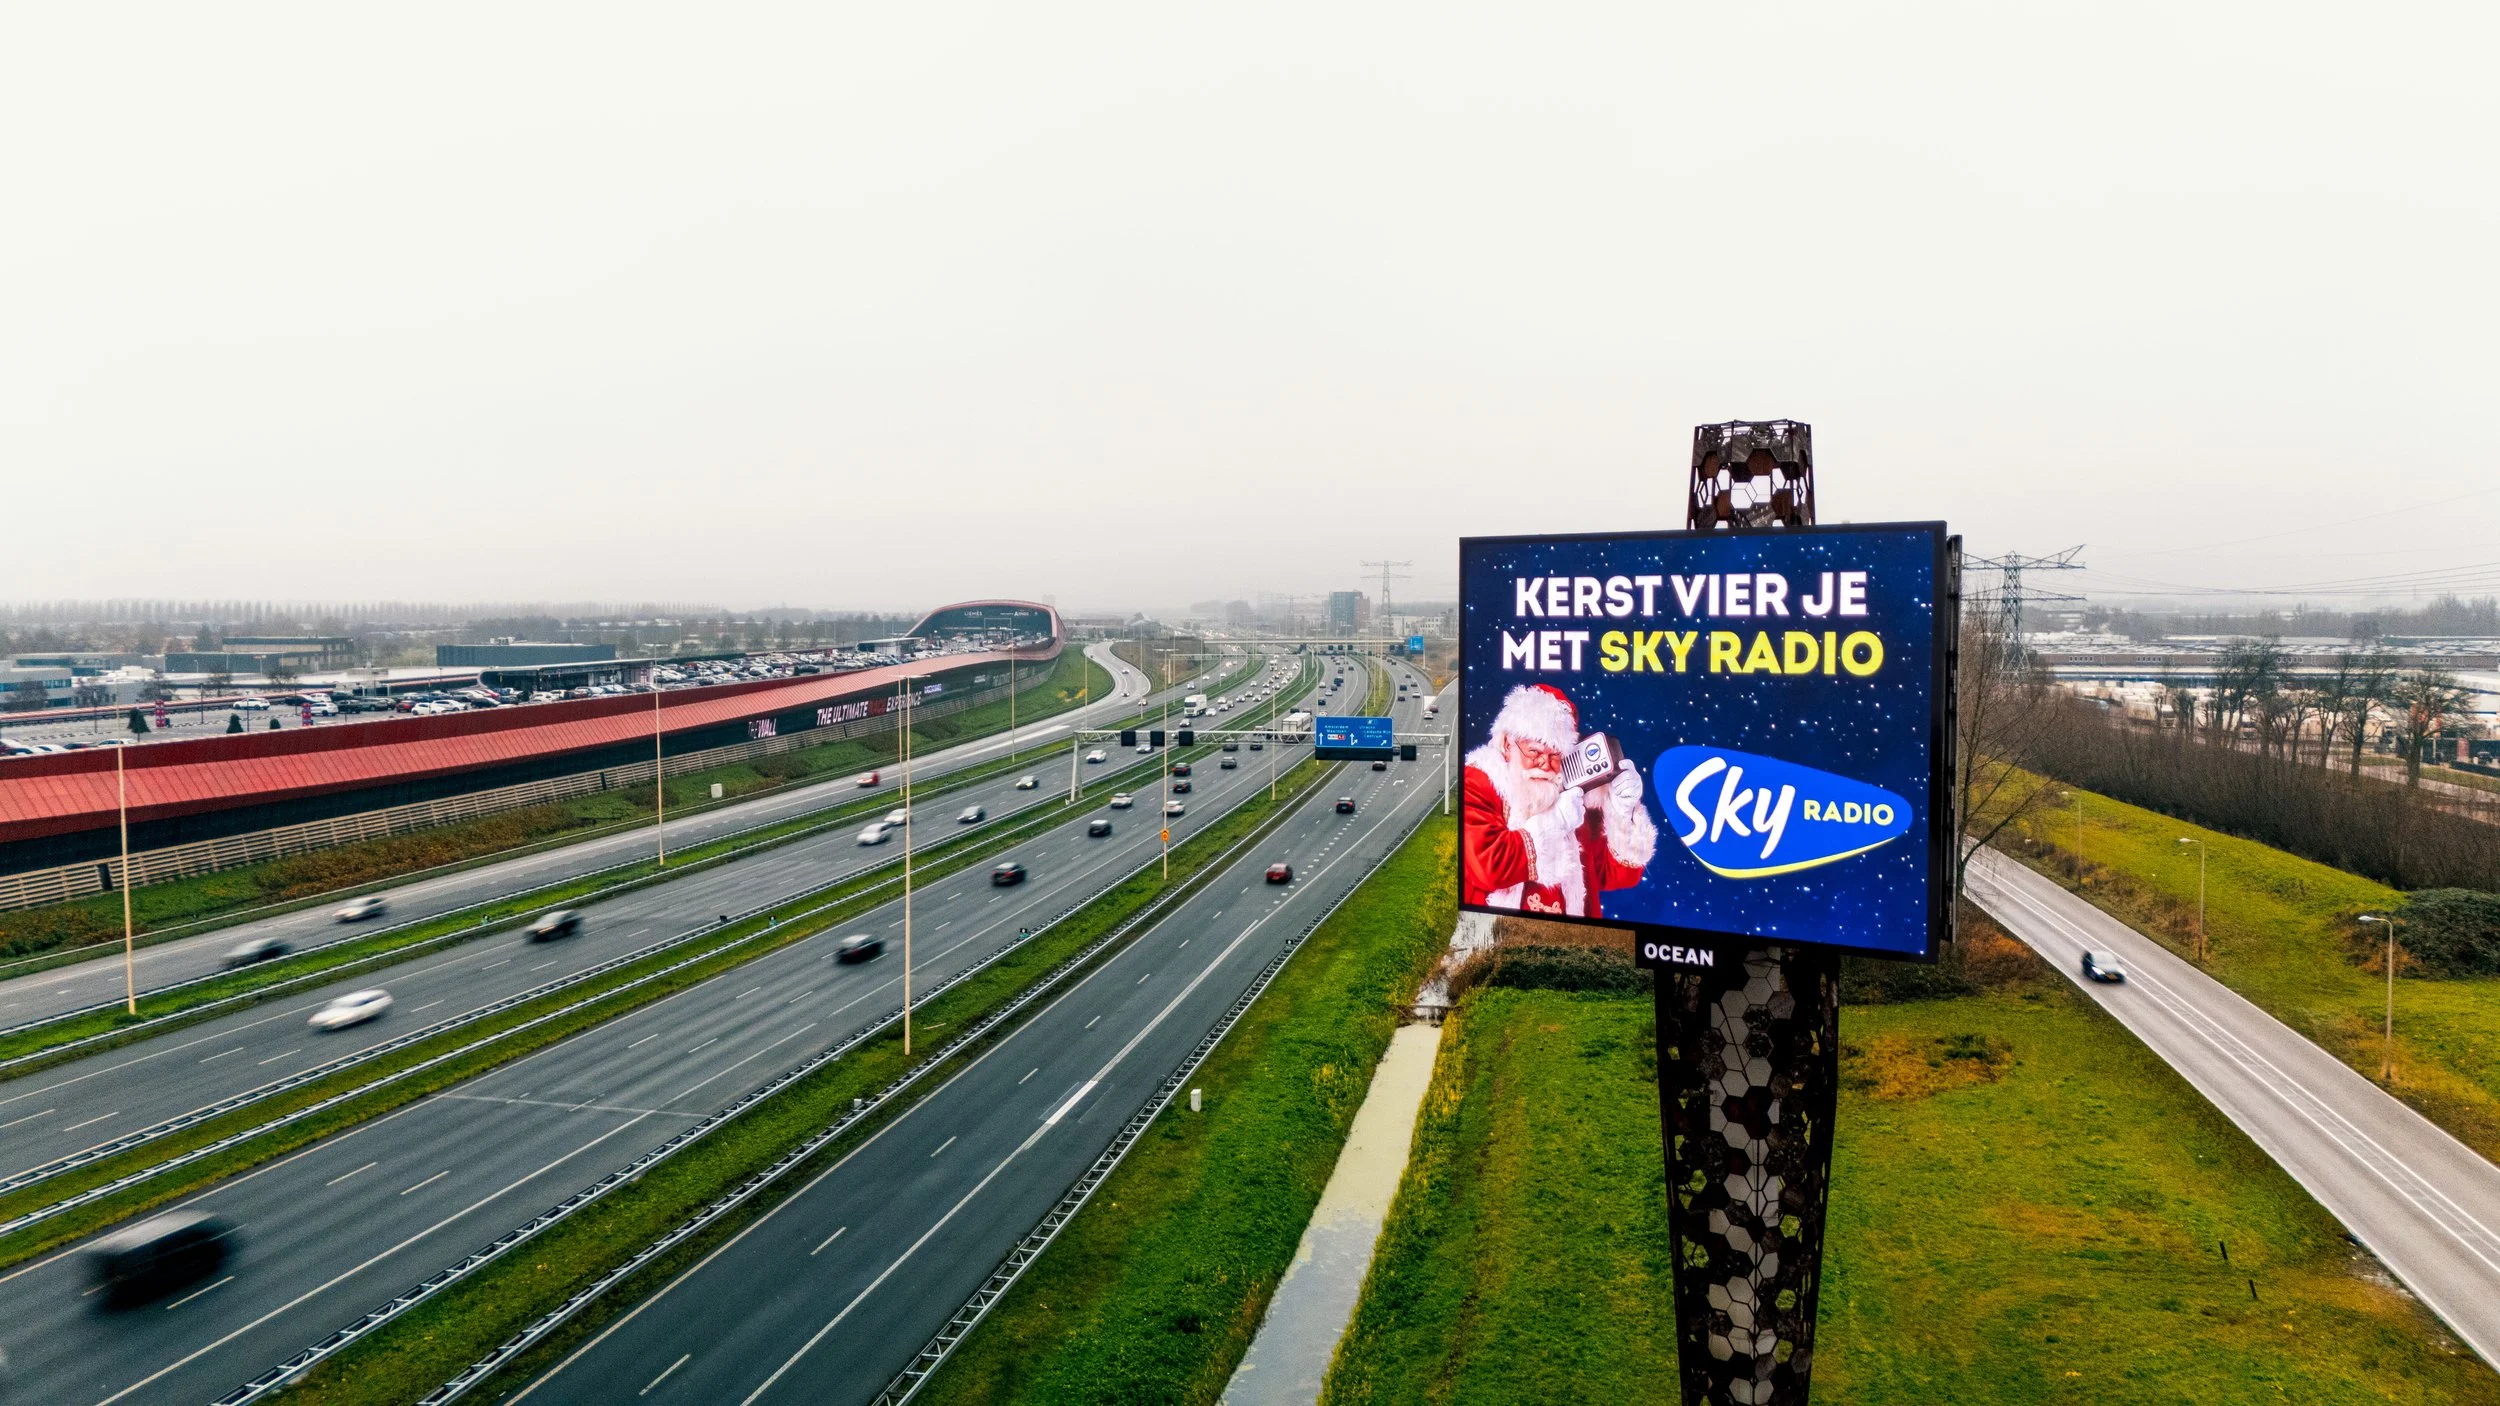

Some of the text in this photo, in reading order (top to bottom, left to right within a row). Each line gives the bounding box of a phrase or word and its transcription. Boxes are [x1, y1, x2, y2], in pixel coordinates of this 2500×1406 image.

[1516, 571, 1868, 616] KERST VIER JE
[1502, 631, 1885, 677] MET SKY RADIO
[817, 708, 832, 726] THE
[832, 701, 869, 722] ULTIMATE
[1675, 756, 1894, 860] Sky RADIO
[1644, 942, 1714, 967] OCEAN
